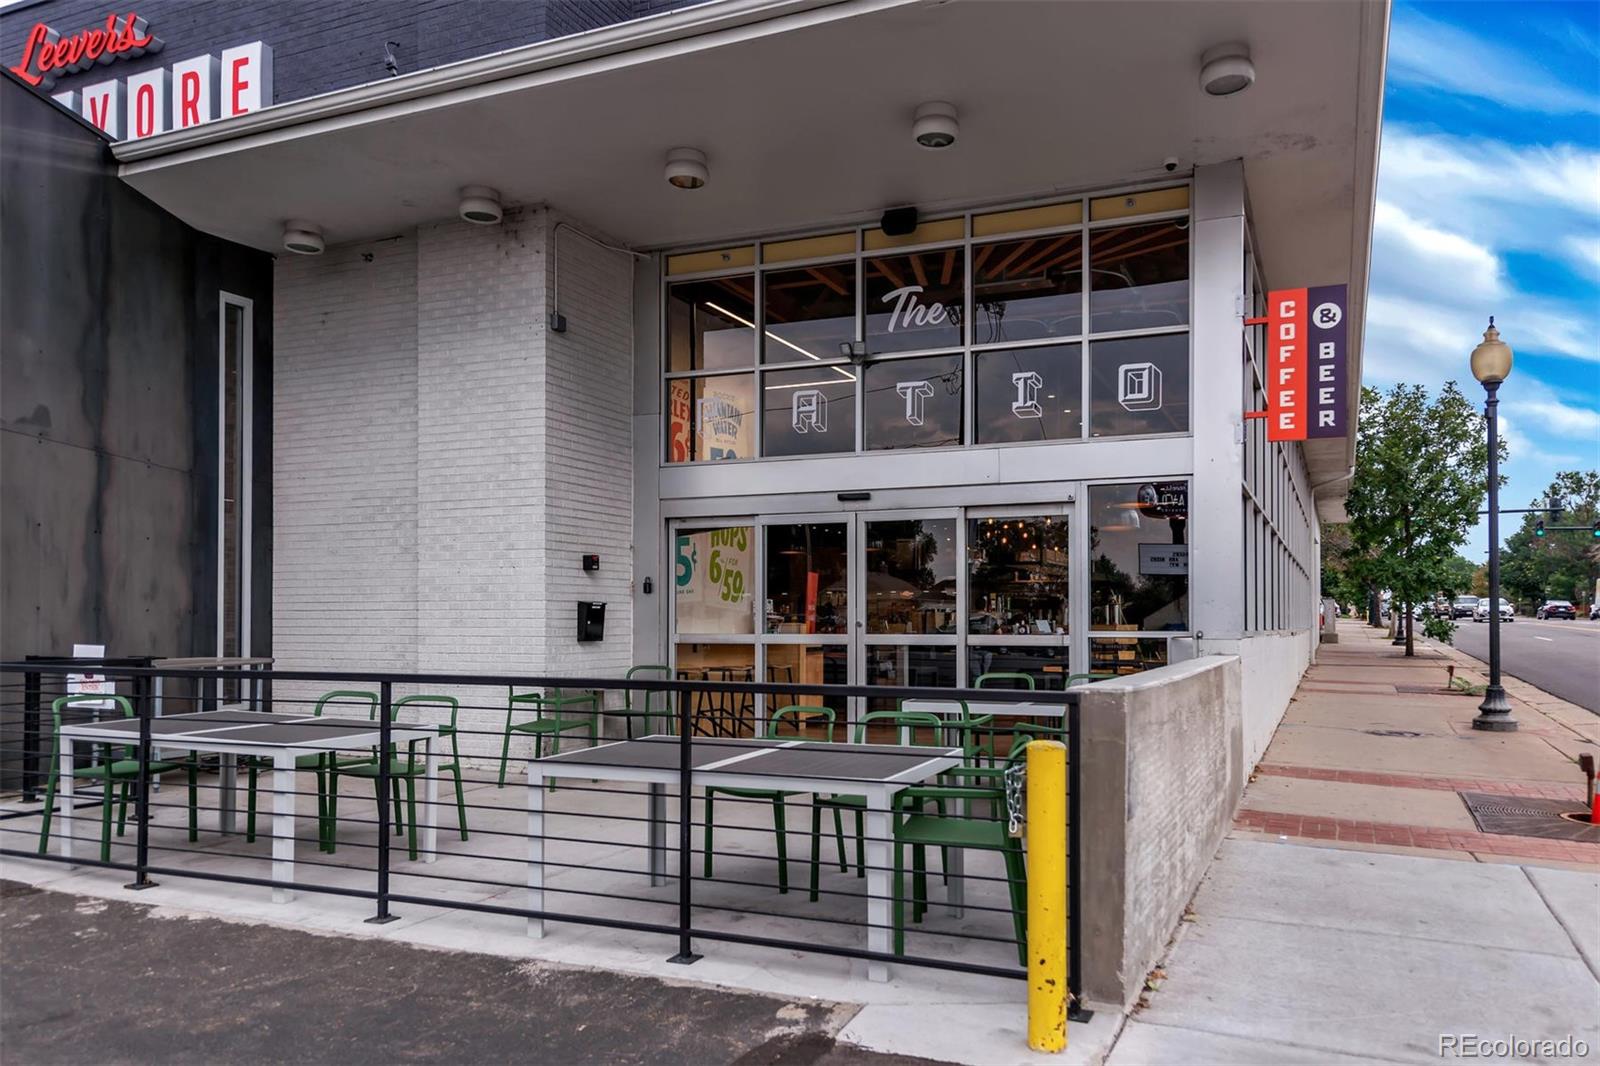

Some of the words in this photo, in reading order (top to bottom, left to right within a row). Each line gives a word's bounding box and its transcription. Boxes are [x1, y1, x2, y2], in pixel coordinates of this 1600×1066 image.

[881, 285, 948, 333] The
[1279, 300, 1296, 430] COFFEE
[1319, 341, 1336, 428] BEER
[713, 420, 738, 440] WATER
